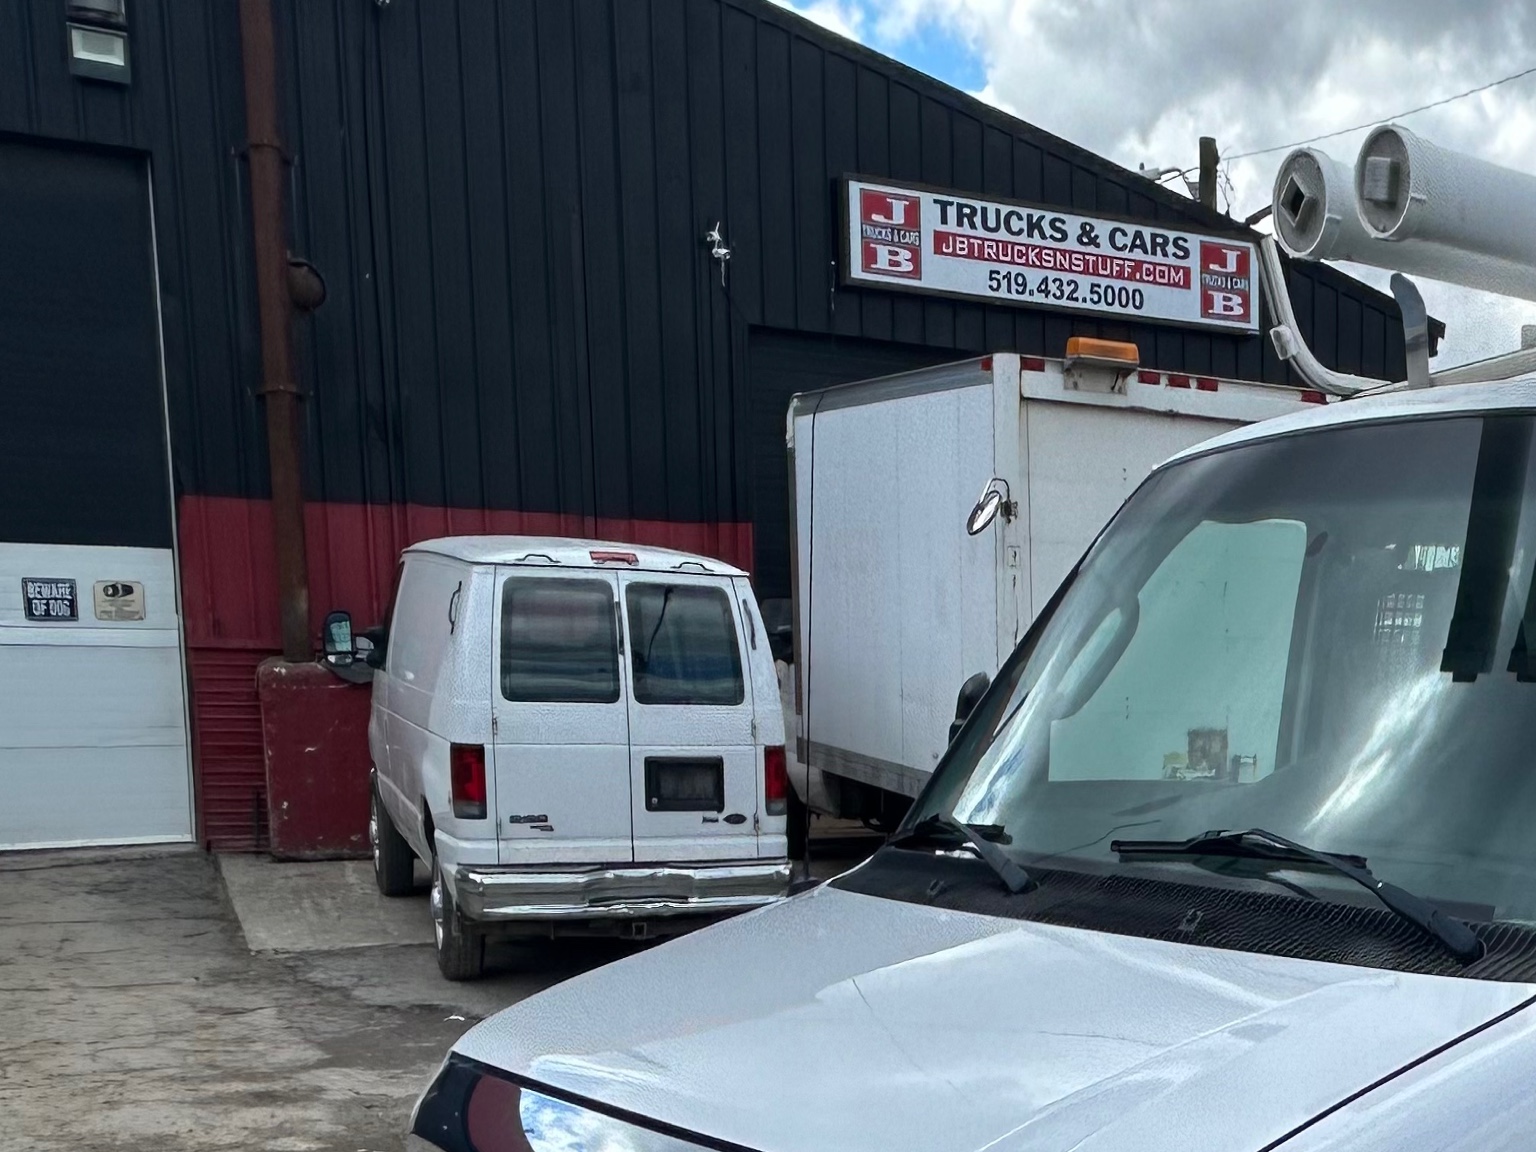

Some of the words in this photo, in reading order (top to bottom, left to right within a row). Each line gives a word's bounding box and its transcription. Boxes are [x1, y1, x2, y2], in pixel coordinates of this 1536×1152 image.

[871, 198, 909, 225] J
[933, 198, 1069, 243] TRUCKS
[1076, 221, 1101, 248] &
[1108, 227, 1191, 260] CARS
[870, 243, 914, 273] B
[942, 236, 1184, 286] JBTRUCKSNSTUFF.COM
[1209, 249, 1242, 273] J
[988, 270, 1145, 310] 519.432.5000
[1207, 290, 1245, 316] B
[27, 581, 72, 599] BEWARE
[32, 600, 47, 616] OF
